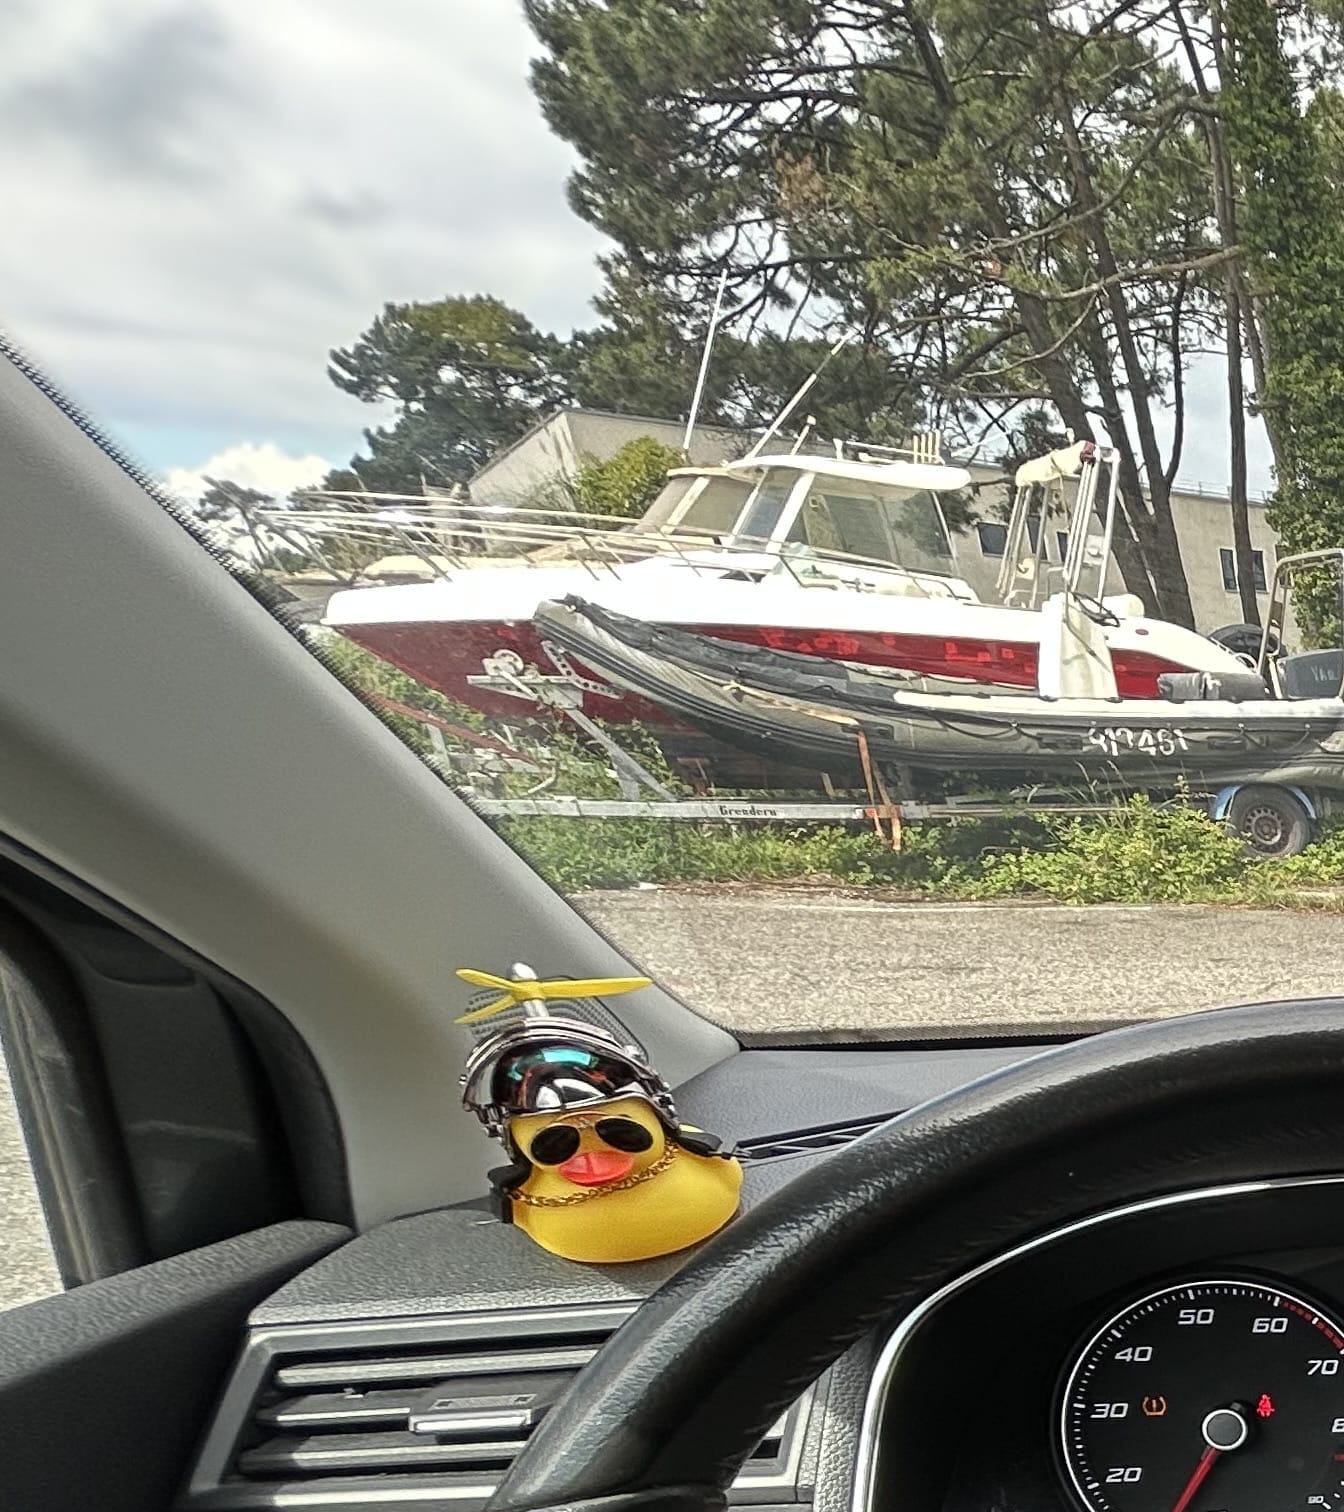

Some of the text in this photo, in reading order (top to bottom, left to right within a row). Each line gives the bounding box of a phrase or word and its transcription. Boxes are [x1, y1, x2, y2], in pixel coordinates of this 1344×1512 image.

[1178, 1309, 1214, 1325] 50
[1252, 1318, 1288, 1333] 60
[1115, 1347, 1152, 1362] 40
[1307, 1359, 1339, 1375] 70
[1090, 1403, 1128, 1418] 30
[1106, 1467, 1142, 1483] 20
